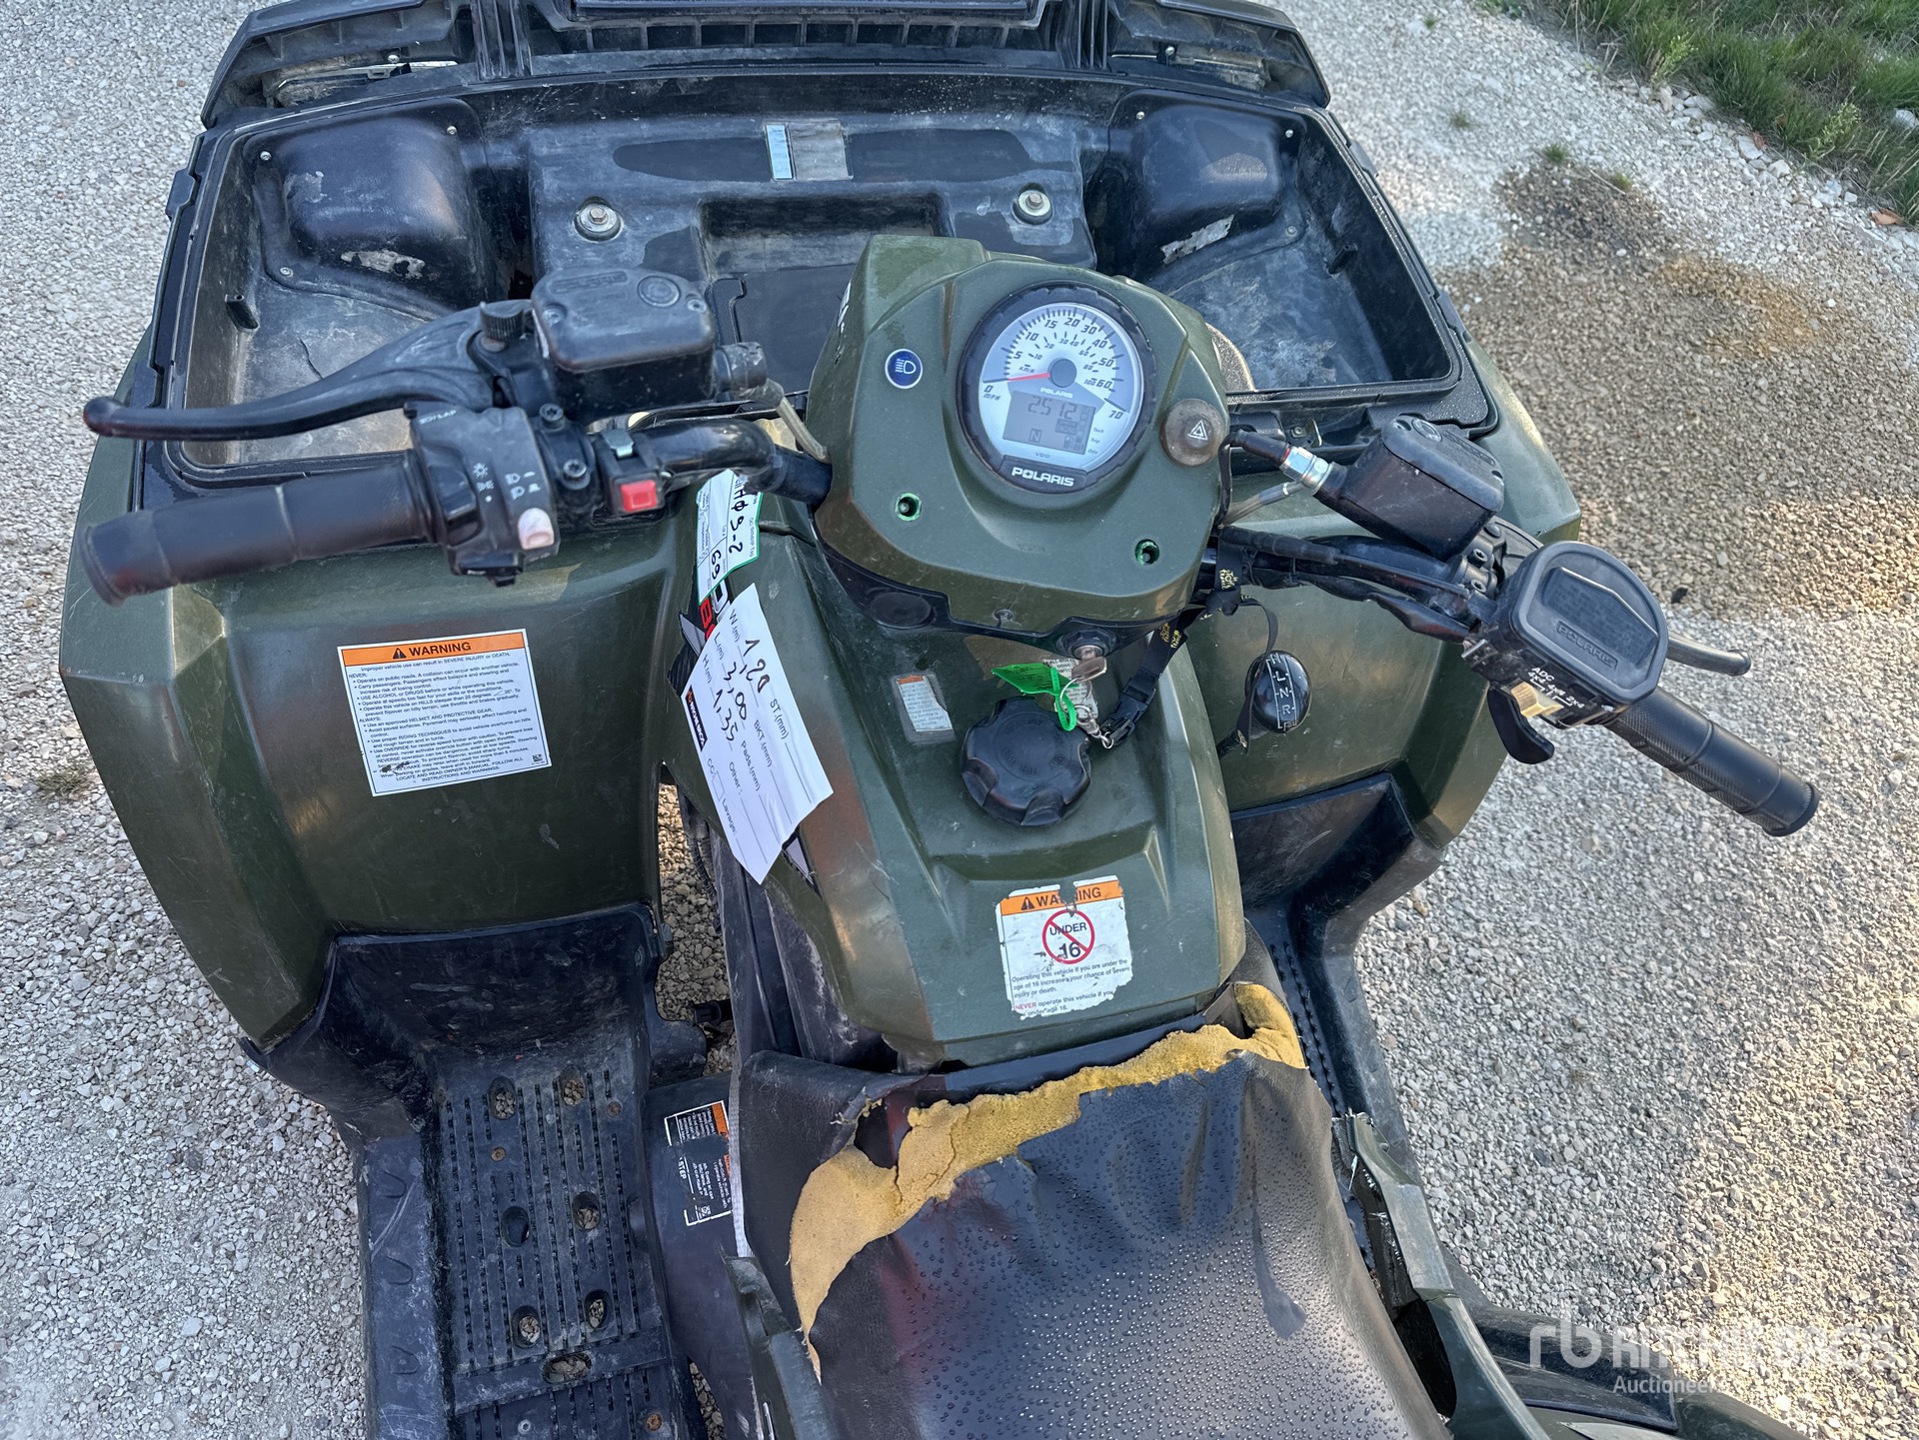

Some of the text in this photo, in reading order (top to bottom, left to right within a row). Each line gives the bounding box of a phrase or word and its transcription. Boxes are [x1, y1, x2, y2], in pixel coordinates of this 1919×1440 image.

[1044, 320, 1058, 329] 15
[1064, 317, 1080, 327] 20
[1080, 324, 1097, 335] 30
[1025, 332, 1039, 341] 10
[1092, 339, 1108, 348] 40
[1013, 351, 1023, 359] 5
[1098, 357, 1115, 367] 50
[984, 384, 994, 393] 0
[1096, 379, 1113, 389] 60
[1040, 387, 1073, 399] POLARIS
[1108, 410, 1124, 420] 70
[1011, 466, 1075, 487] POLARIS
[711, 549, 722, 580] 69
[409, 641, 471, 657] WARNING
[1558, 625, 1615, 668] POLARIS
[1270, 653, 1281, 664] H
[1275, 671, 1286, 681] L
[1531, 667, 1555, 681] ADC
[723, 661, 747, 720] 3,00
[1279, 686, 1289, 698] N
[1282, 704, 1290, 715] R
[713, 689, 739, 742] 1,35
[1283, 721, 1292, 731] P
[1036, 887, 1101, 907] WAING
[1049, 922, 1087, 936] UNDER
[1058, 942, 1081, 960] 16
[1015, 1002, 1037, 1010] NEVER
[678, 1160, 687, 1179] STEP
